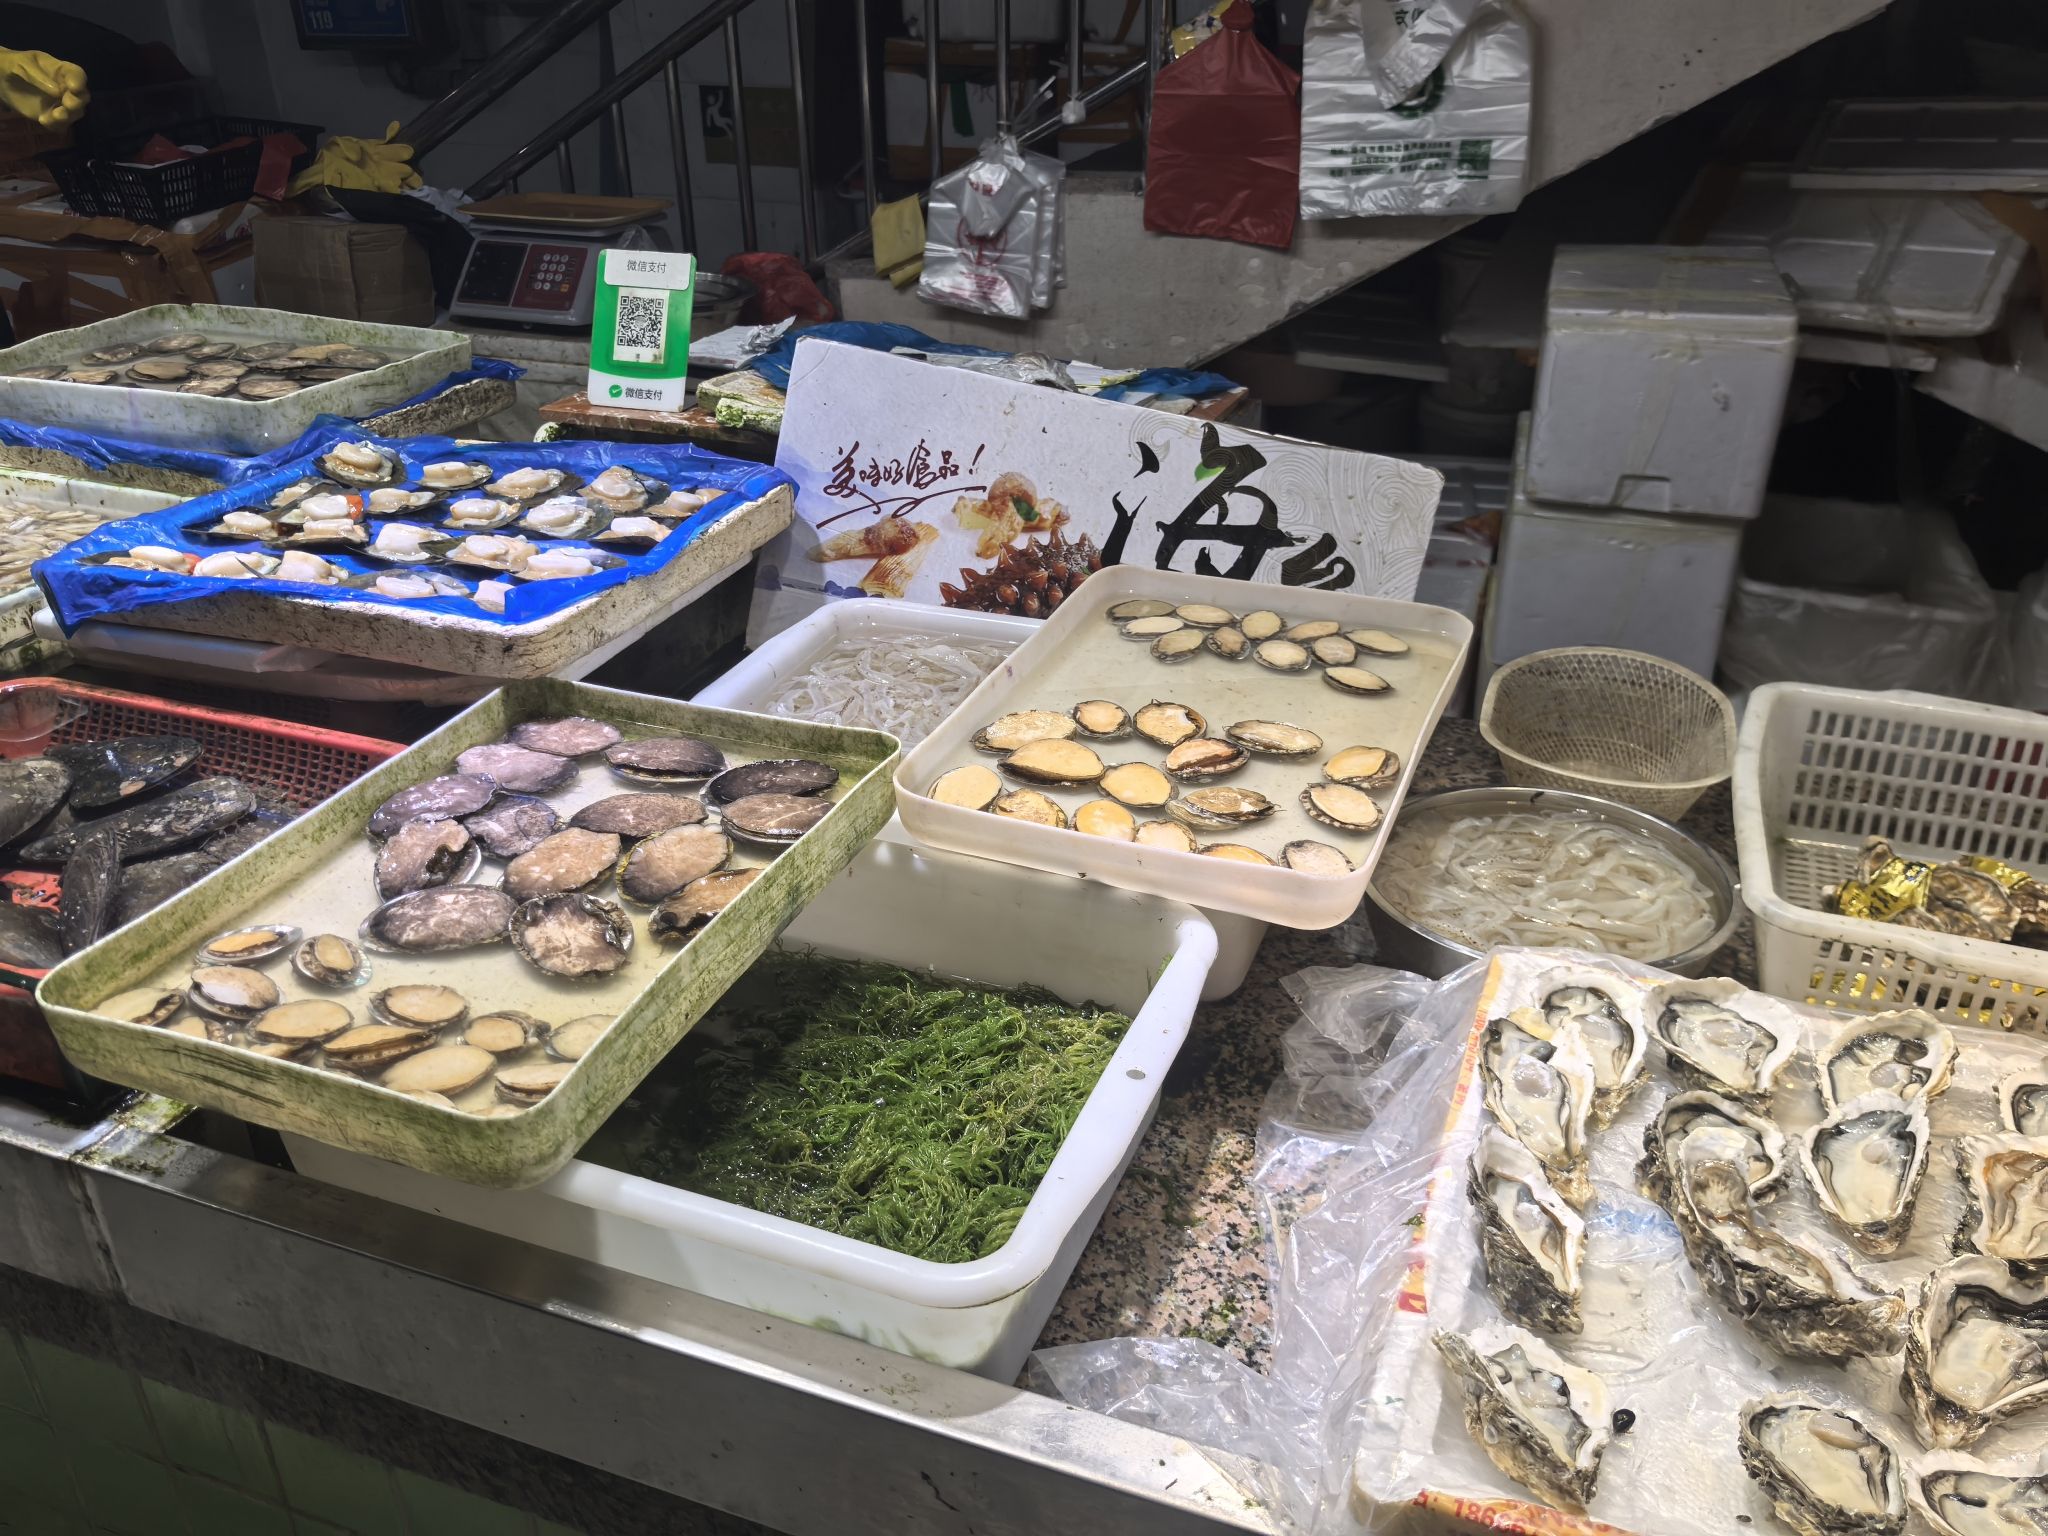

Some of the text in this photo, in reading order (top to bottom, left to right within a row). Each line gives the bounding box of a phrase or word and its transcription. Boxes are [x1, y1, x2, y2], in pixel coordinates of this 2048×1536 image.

[626, 259, 667, 274] 微信支付
[625, 386, 663, 401] 微信支付
